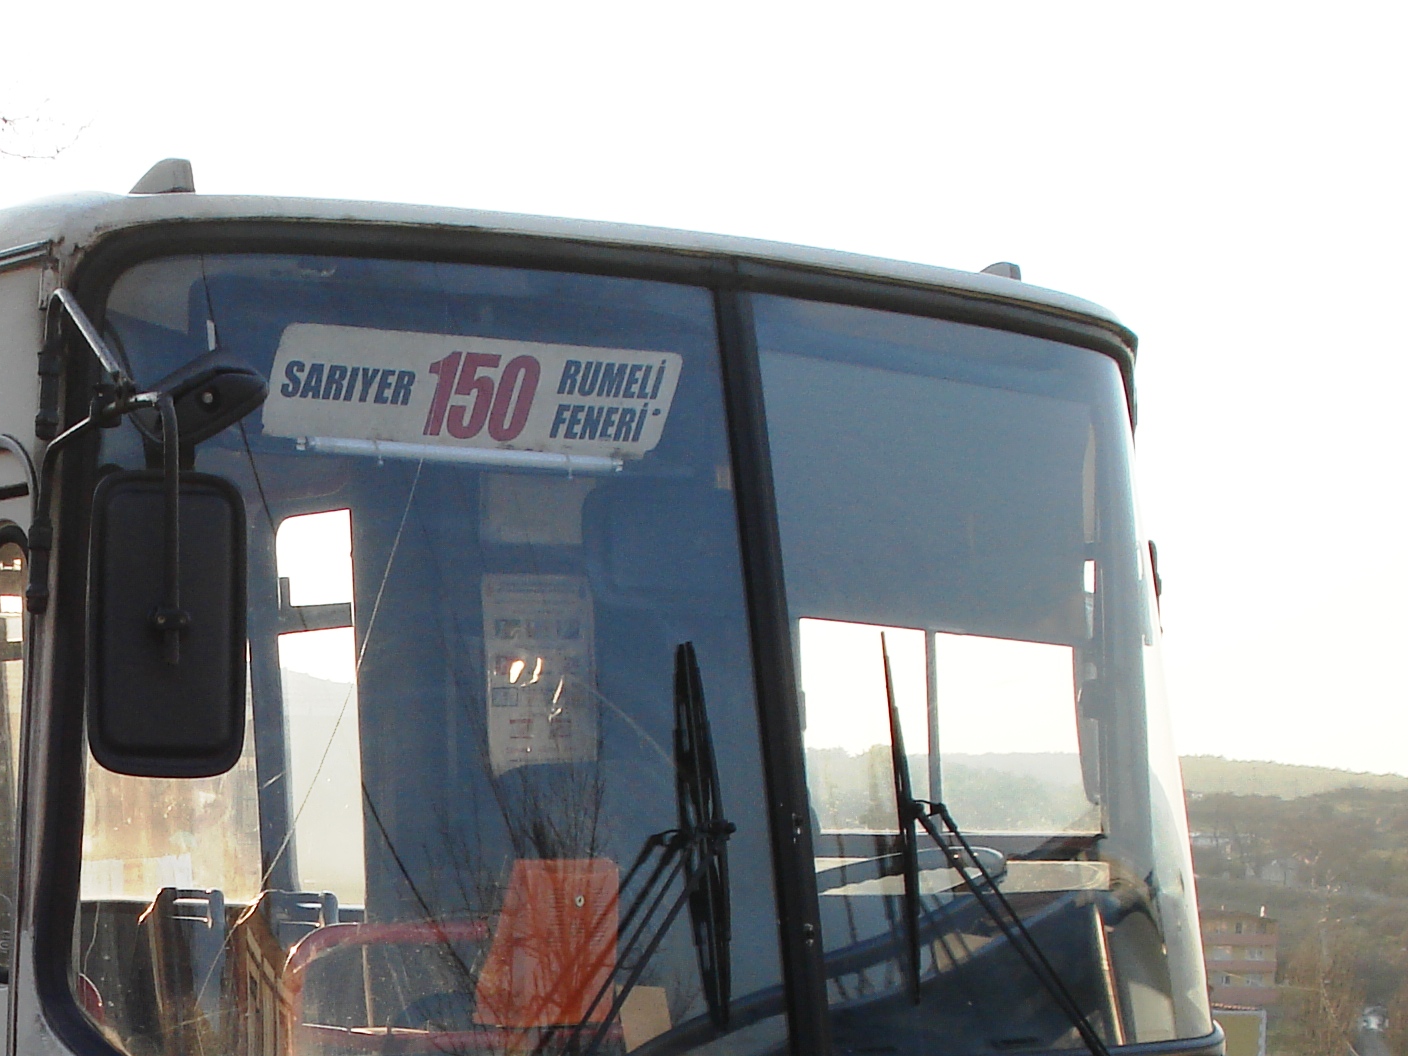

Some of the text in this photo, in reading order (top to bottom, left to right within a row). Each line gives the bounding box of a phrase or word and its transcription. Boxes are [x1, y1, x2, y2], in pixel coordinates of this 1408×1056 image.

[280, 351, 541, 442] SARIYER 150
[556, 358, 667, 400] RUMELİ
[549, 402, 649, 443] FENERİ
